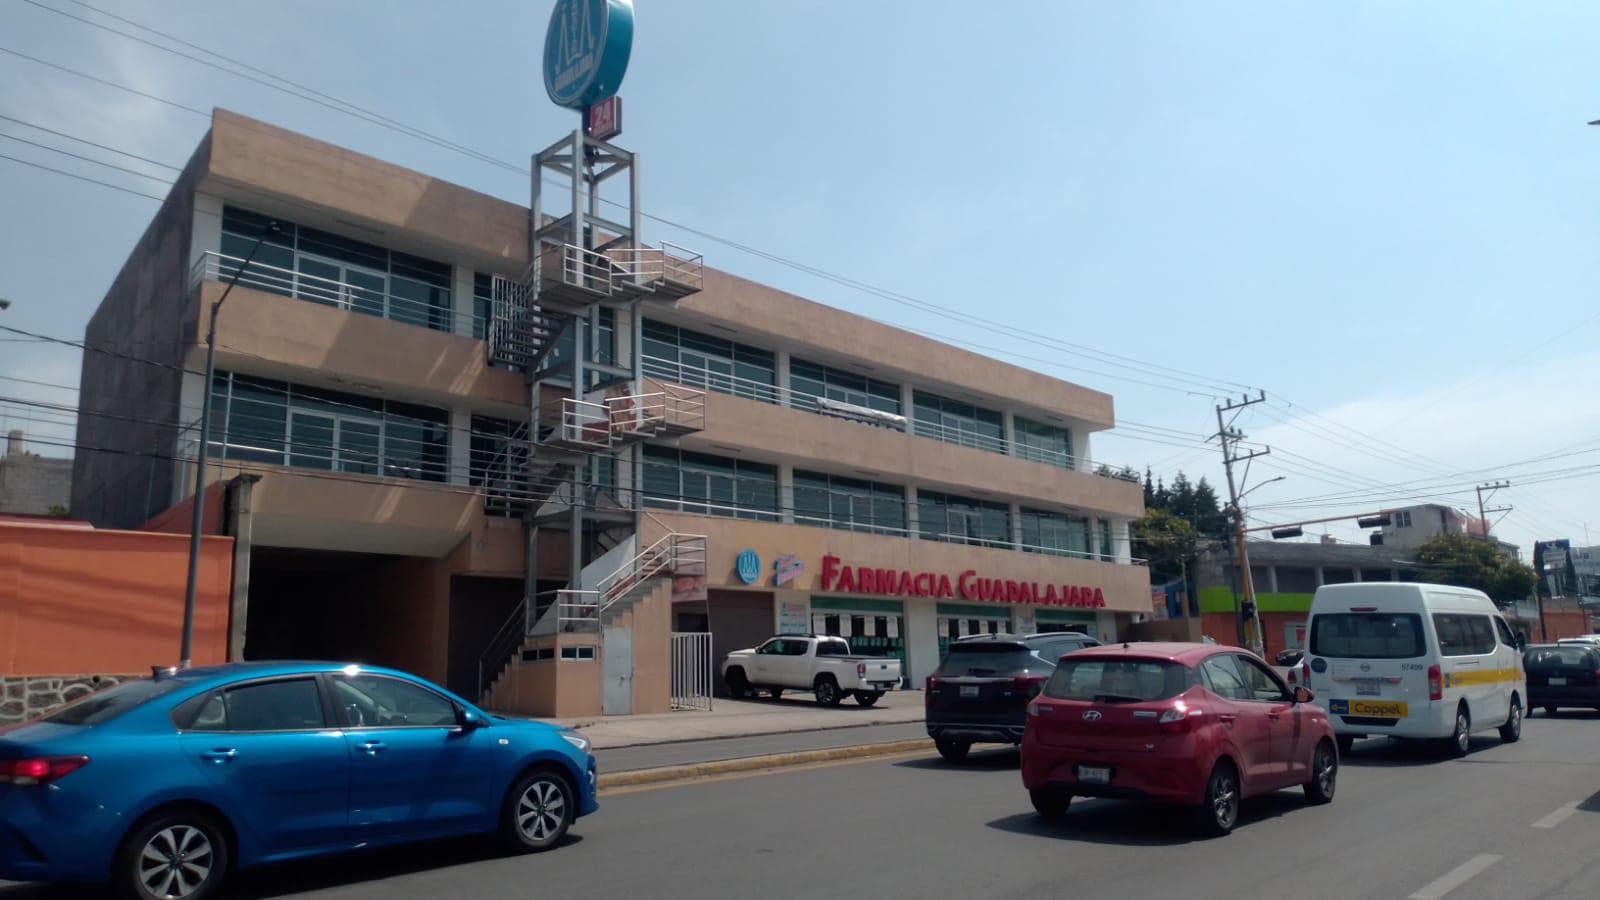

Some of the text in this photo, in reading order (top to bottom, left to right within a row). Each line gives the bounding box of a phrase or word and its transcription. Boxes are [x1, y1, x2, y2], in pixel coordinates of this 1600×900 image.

[594, 100, 612, 125] 24
[821, 554, 954, 597] FARMACIA
[958, 569, 1106, 608] GUADALAJARA
[1354, 702, 1401, 716] Coppel
